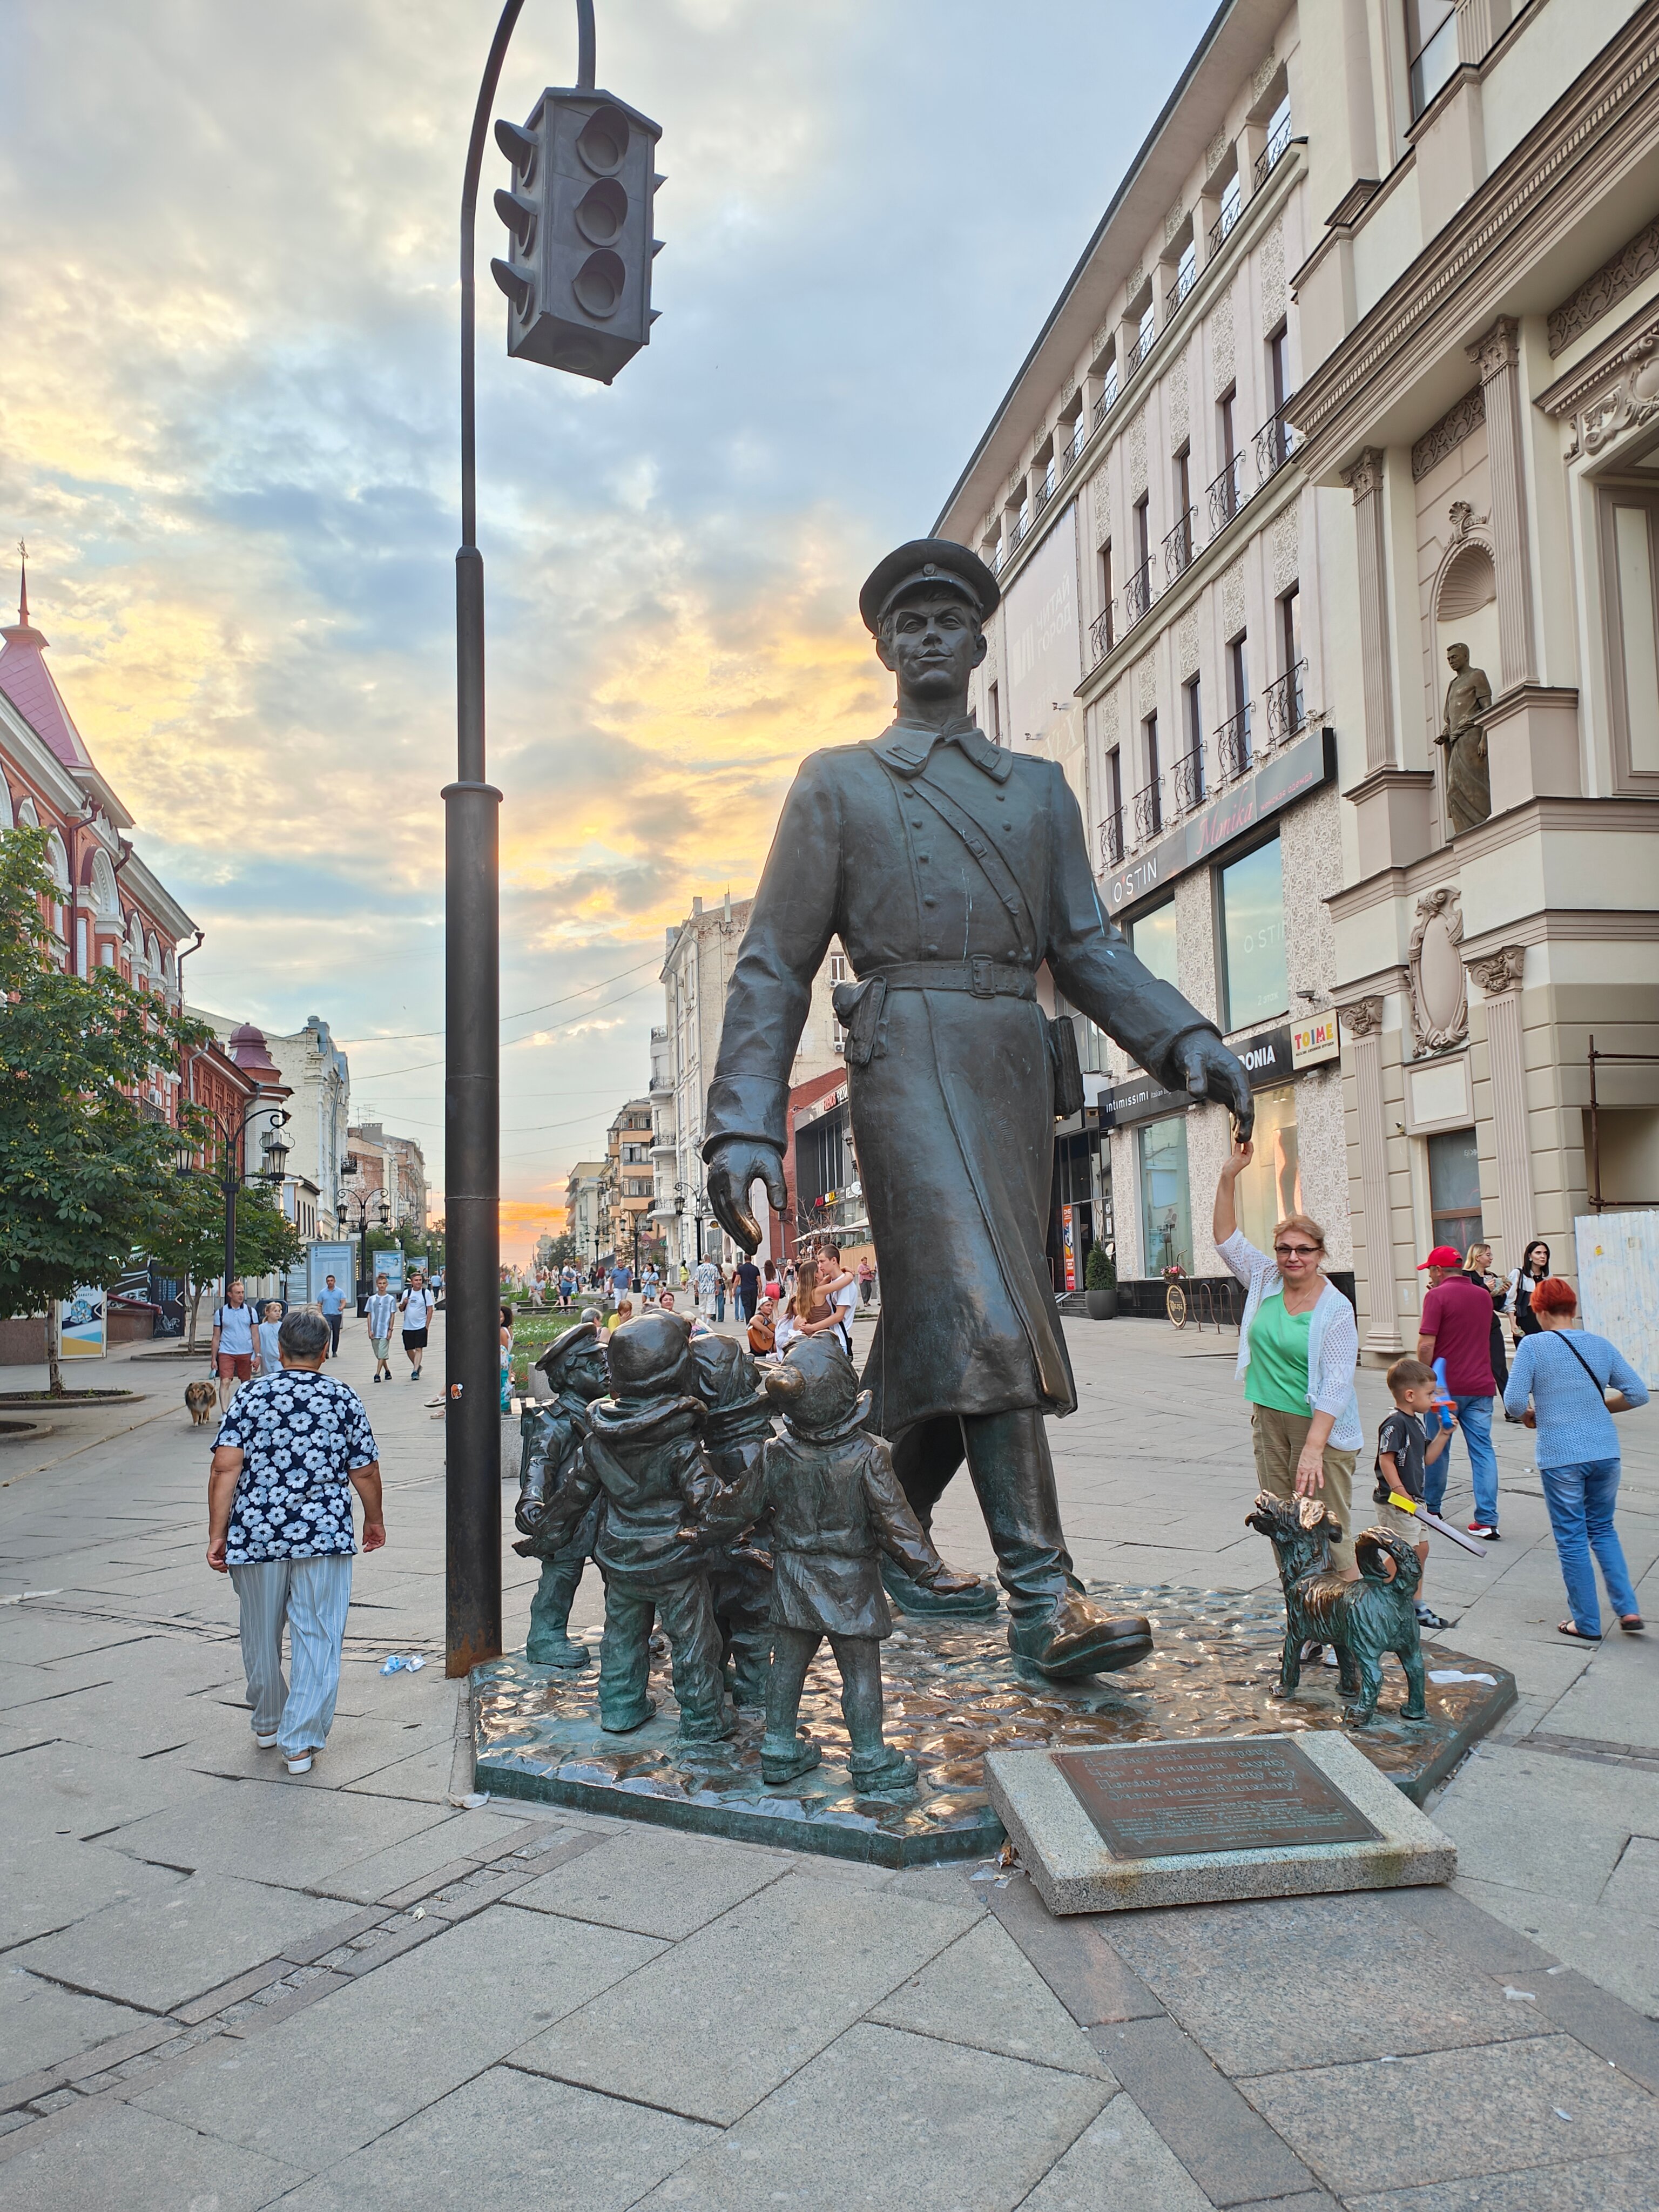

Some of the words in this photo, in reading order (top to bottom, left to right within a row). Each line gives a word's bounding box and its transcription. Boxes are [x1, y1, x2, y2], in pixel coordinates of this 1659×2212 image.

[1036, 570, 1070, 631] ЧИТАЙ
[1038, 601, 1072, 659] ГОРОД
[1288, 771, 1313, 793] одежда
[1196, 786, 1253, 854] Monika
[1263, 992, 1279, 1004] этаж
[1294, 1022, 1334, 1050] TOIME
